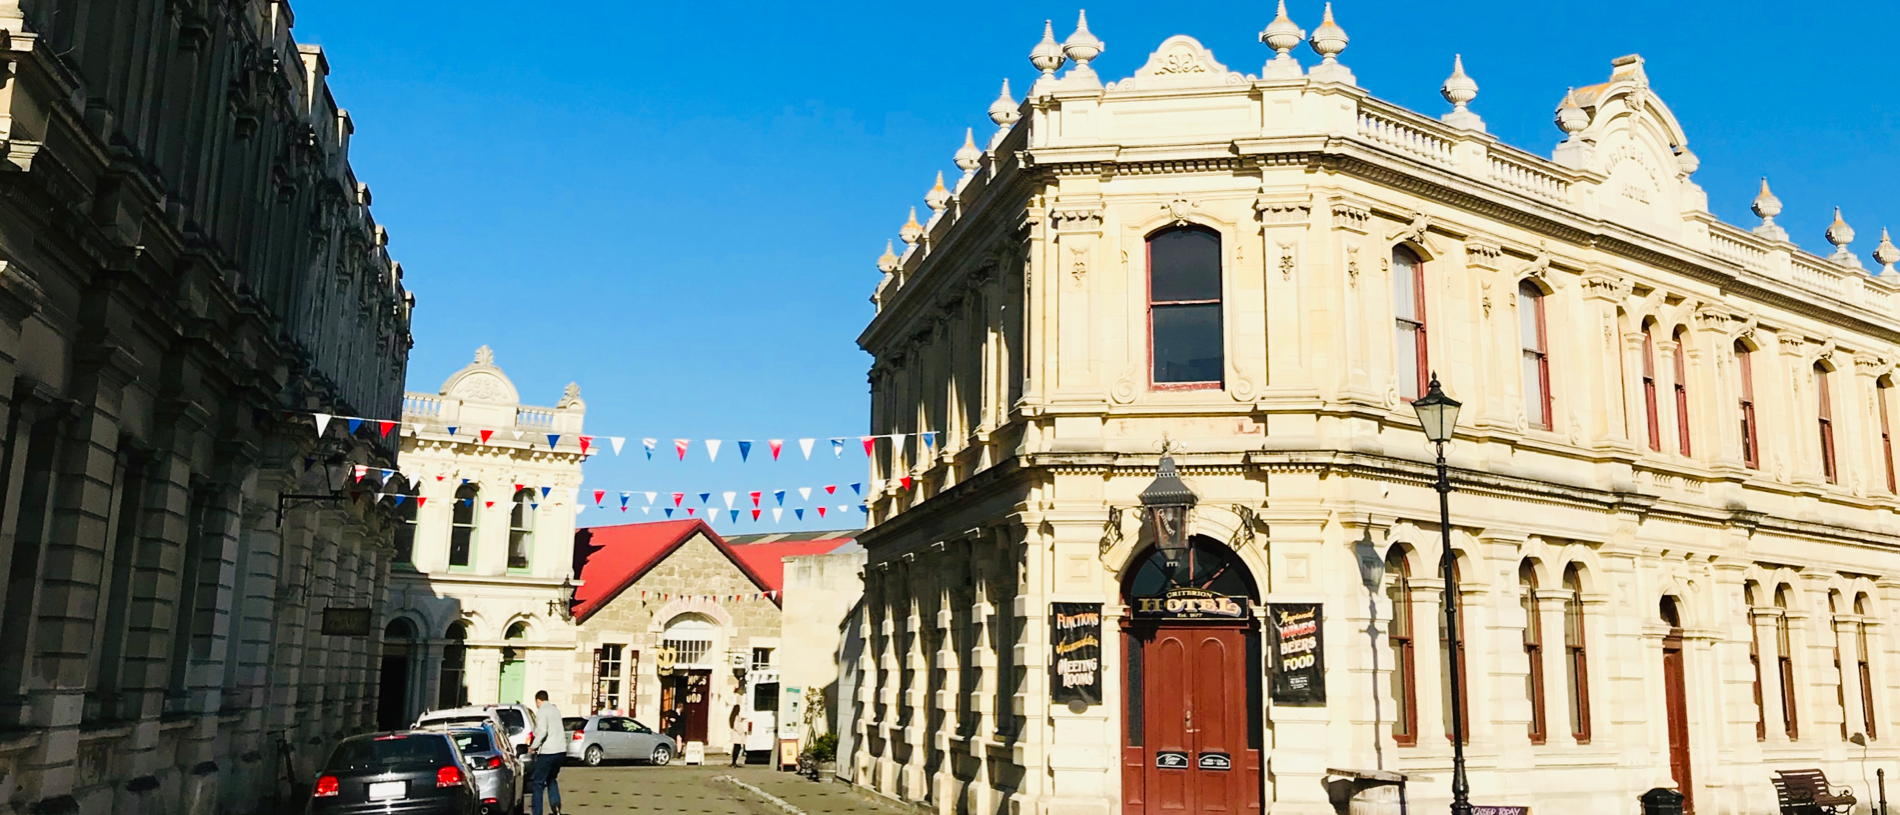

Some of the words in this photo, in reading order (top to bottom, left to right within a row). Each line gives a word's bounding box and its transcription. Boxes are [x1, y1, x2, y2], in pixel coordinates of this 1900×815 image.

[1166, 590, 1213, 599] CRITERION
[1138, 597, 1242, 617] HOTEL
[1280, 620, 1317, 639] WINES
[1280, 636, 1317, 655] BEERS
[1057, 658, 1097, 675] MEETING
[1283, 654, 1315, 672] FOOD
[592, 652, 600, 706] HARBOUR
[1062, 671, 1094, 688] ROOMS
